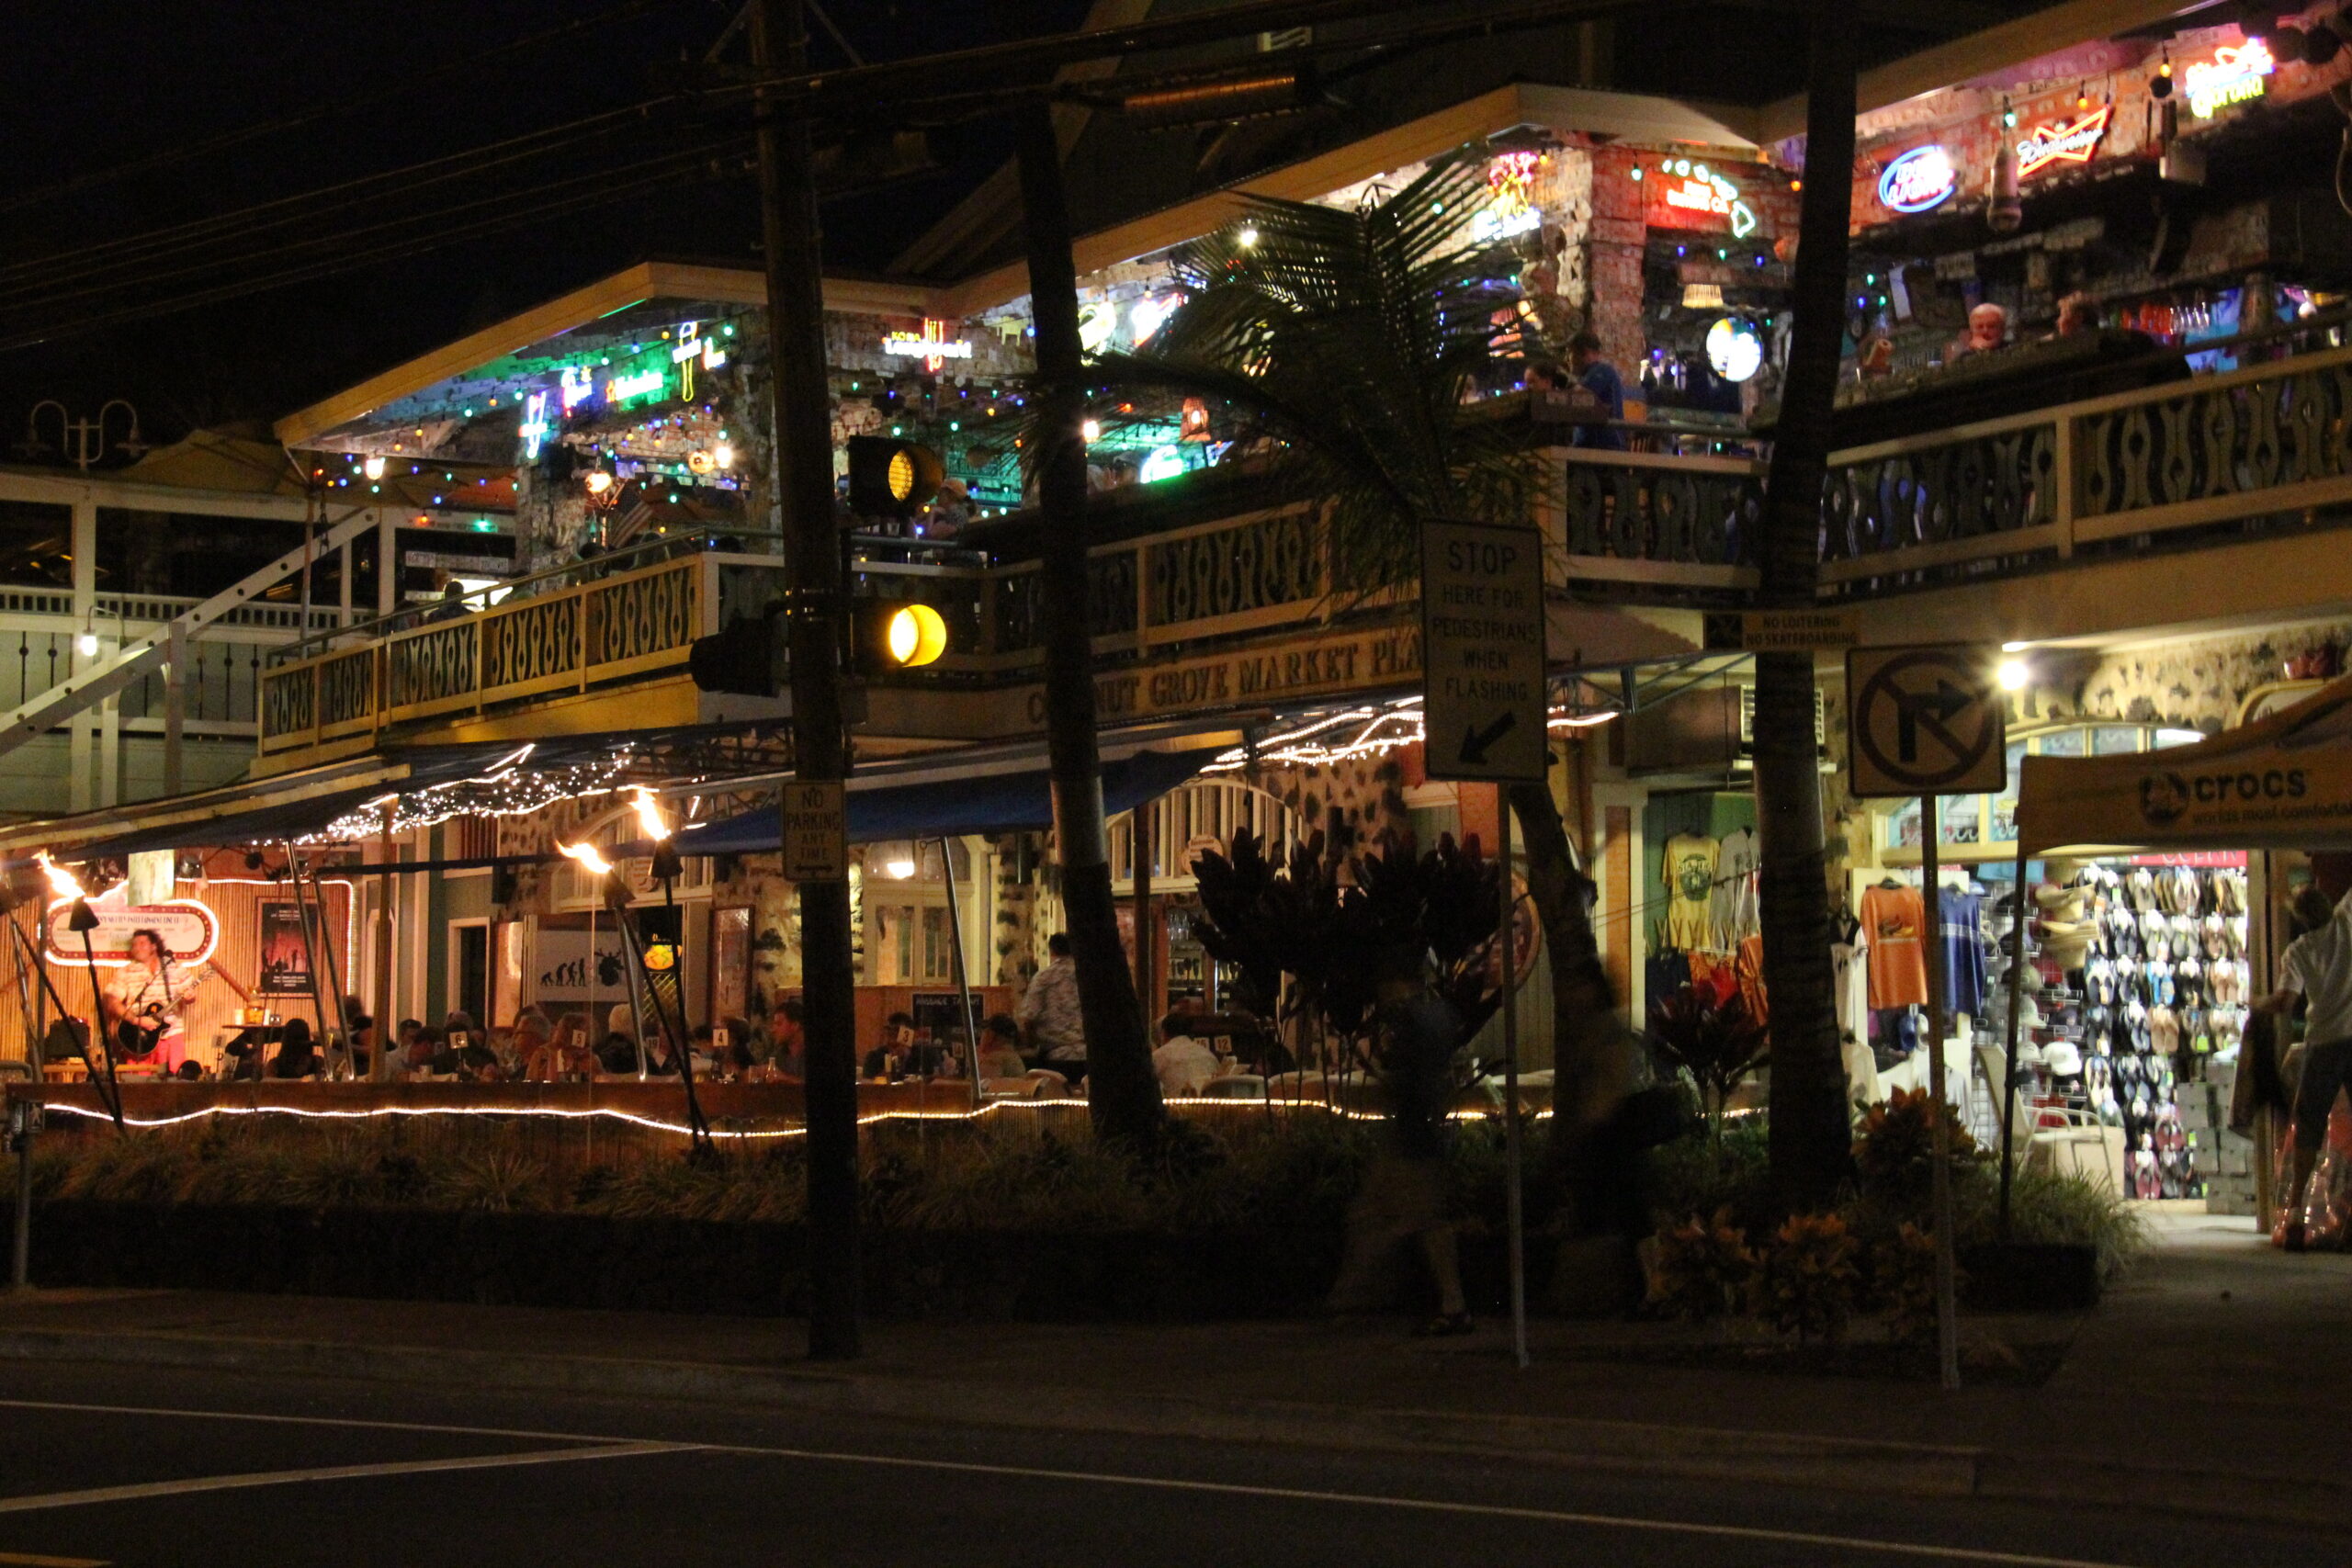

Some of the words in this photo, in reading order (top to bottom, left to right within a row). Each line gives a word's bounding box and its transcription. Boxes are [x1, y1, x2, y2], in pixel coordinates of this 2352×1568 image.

[2191, 74, 2264, 118] Corona
[1449, 540, 1517, 575] STOP
[1442, 585, 1486, 606] HERE
[1492, 588, 1523, 608] FOR
[1432, 616, 1537, 643] PEDESTRIANS
[1763, 616, 1780, 627] NO
[1782, 616, 1839, 627] LOITERING
[1747, 632, 1762, 645] NO
[1765, 631, 1858, 646] SKATEBOARDING
[1464, 650, 1509, 671] WHEN
[1027, 675, 1140, 724] CNUT
[1151, 662, 1228, 706] GROVE
[1238, 643, 1359, 694] MARKET
[1371, 632, 1422, 678] PLA
[1446, 677, 1528, 701] FLASHING
[2193, 769, 2307, 803] crocs
[802, 790, 823, 808] NO
[787, 812, 839, 830] PARKING
[802, 832, 824, 845] ANY
[800, 847, 827, 861] TIME
[576, 1033, 582, 1044] 5
[718, 1032, 724, 1043] 4
[903, 1030, 910, 1043] 3
[1217, 1038, 1228, 1050] 12
